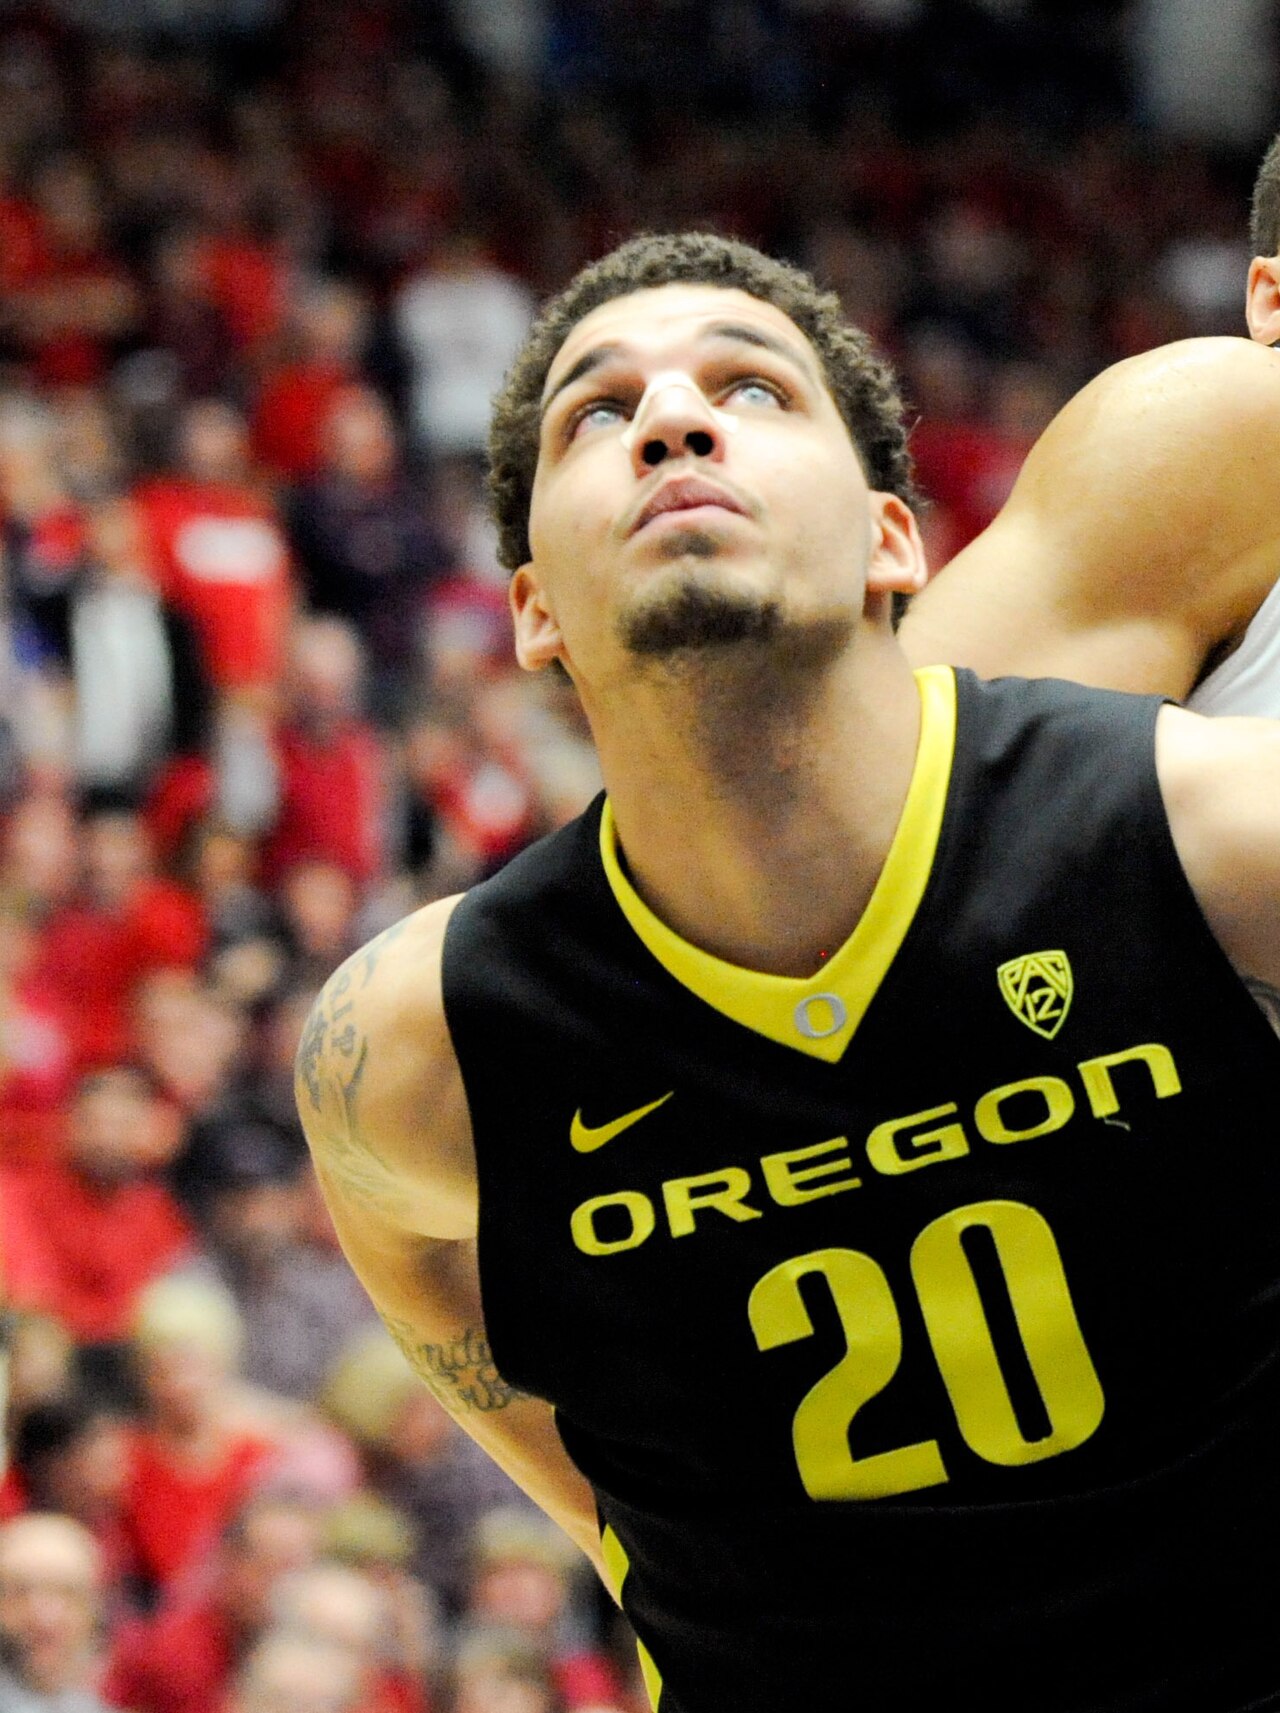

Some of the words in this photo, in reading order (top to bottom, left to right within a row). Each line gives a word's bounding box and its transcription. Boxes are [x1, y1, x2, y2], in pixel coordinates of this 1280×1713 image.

[1002, 956, 1068, 1010] PAC
[1025, 986, 1062, 1024] 12
[794, 992, 847, 1039] O
[570, 1043, 1182, 1256] OREGON
[747, 1200, 1105, 1501] 20
